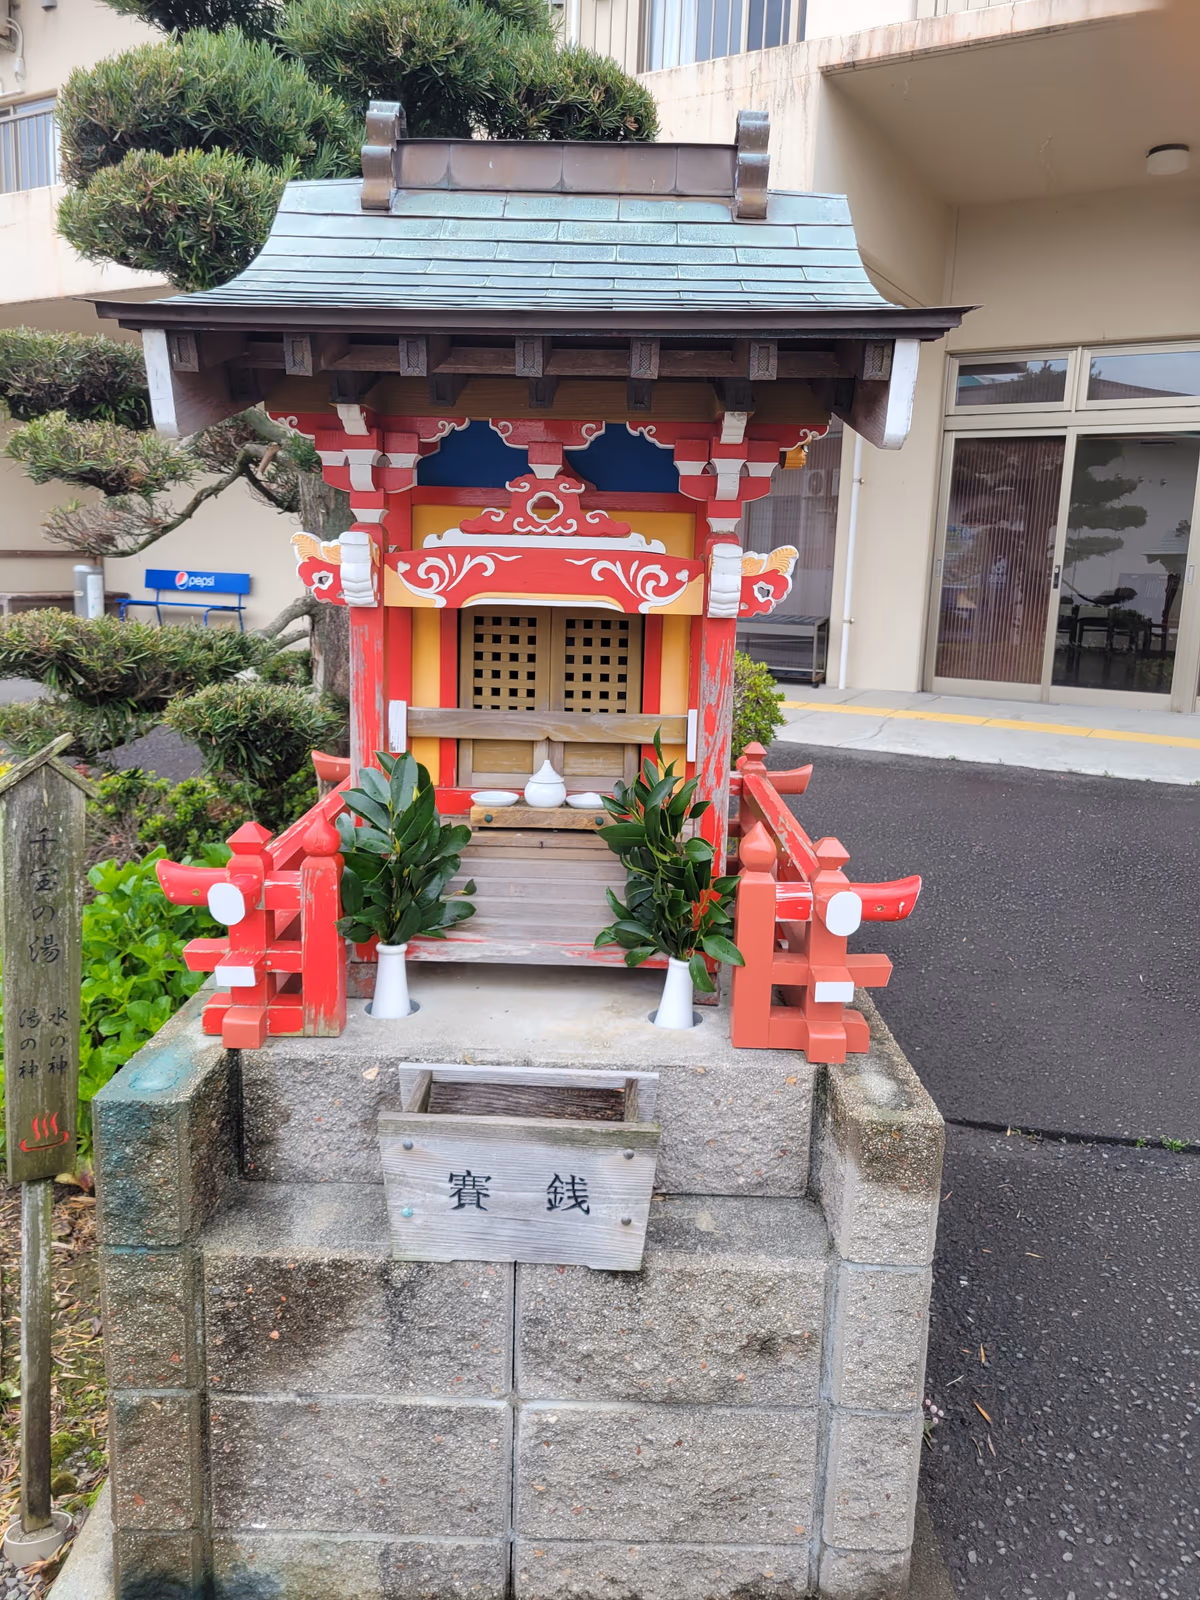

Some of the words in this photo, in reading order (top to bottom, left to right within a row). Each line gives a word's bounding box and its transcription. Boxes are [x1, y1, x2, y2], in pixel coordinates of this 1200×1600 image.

[188, 575, 216, 588] pepsi
[18, 1007, 41, 1080] 湯の神
[48, 1006, 69, 1075] 水の神
[448, 1169, 590, 1215] 賽銭
